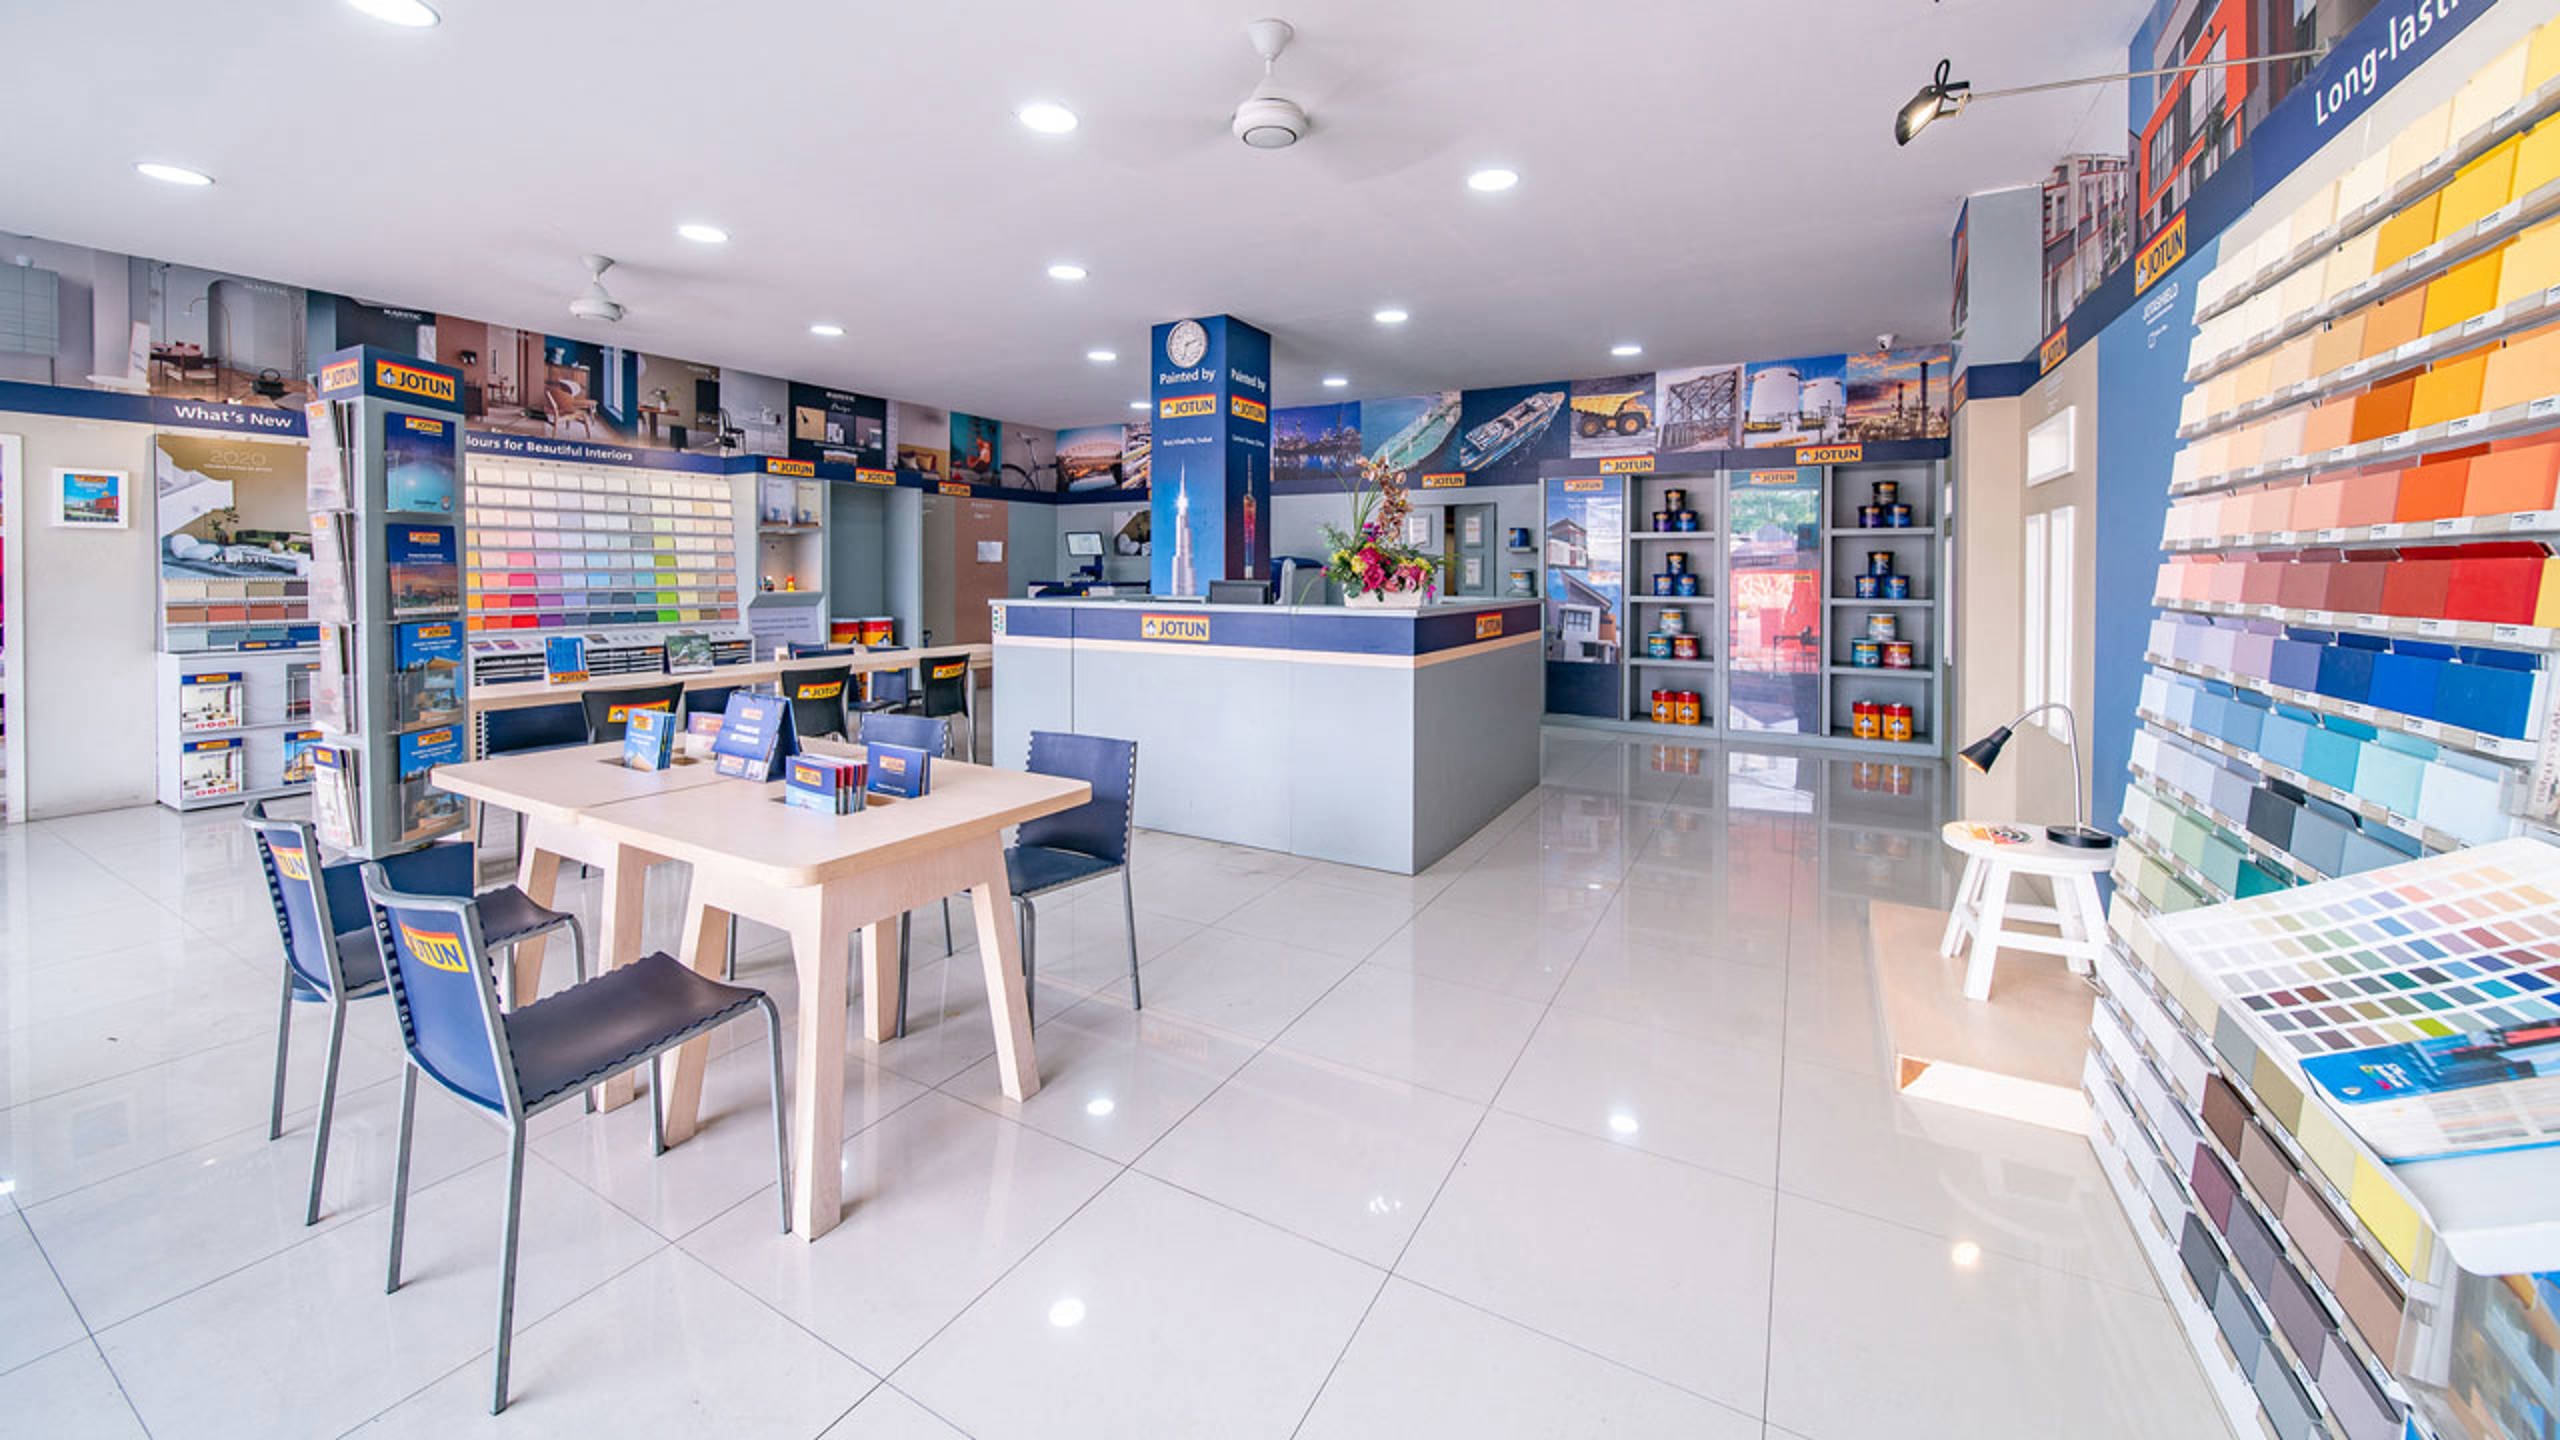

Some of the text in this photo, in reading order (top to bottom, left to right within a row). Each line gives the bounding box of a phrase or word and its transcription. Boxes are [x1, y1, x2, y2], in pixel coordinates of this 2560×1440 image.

[2147, 223, 2184, 281] JOTUN
[330, 364, 358, 387] JOTUN
[1160, 368, 1216, 385] Painted by
[398, 371, 452, 397] JOTUN
[1174, 400, 1213, 415] JOTUN
[251, 412, 292, 429] New
[466, 434, 633, 462] lours for Beautiful Interiors
[1813, 448, 1860, 461] JOTUN
[210, 451, 267, 465] 2020
[781, 463, 813, 474] JOTUN
[1613, 459, 1653, 472] JOTUN
[865, 473, 896, 483] JOTUN
[1433, 475, 1464, 486] JOTUN
[1762, 473, 1795, 482] JOTUN
[1575, 481, 1602, 490] JOTUN
[1160, 620, 1206, 637] JOTUN
